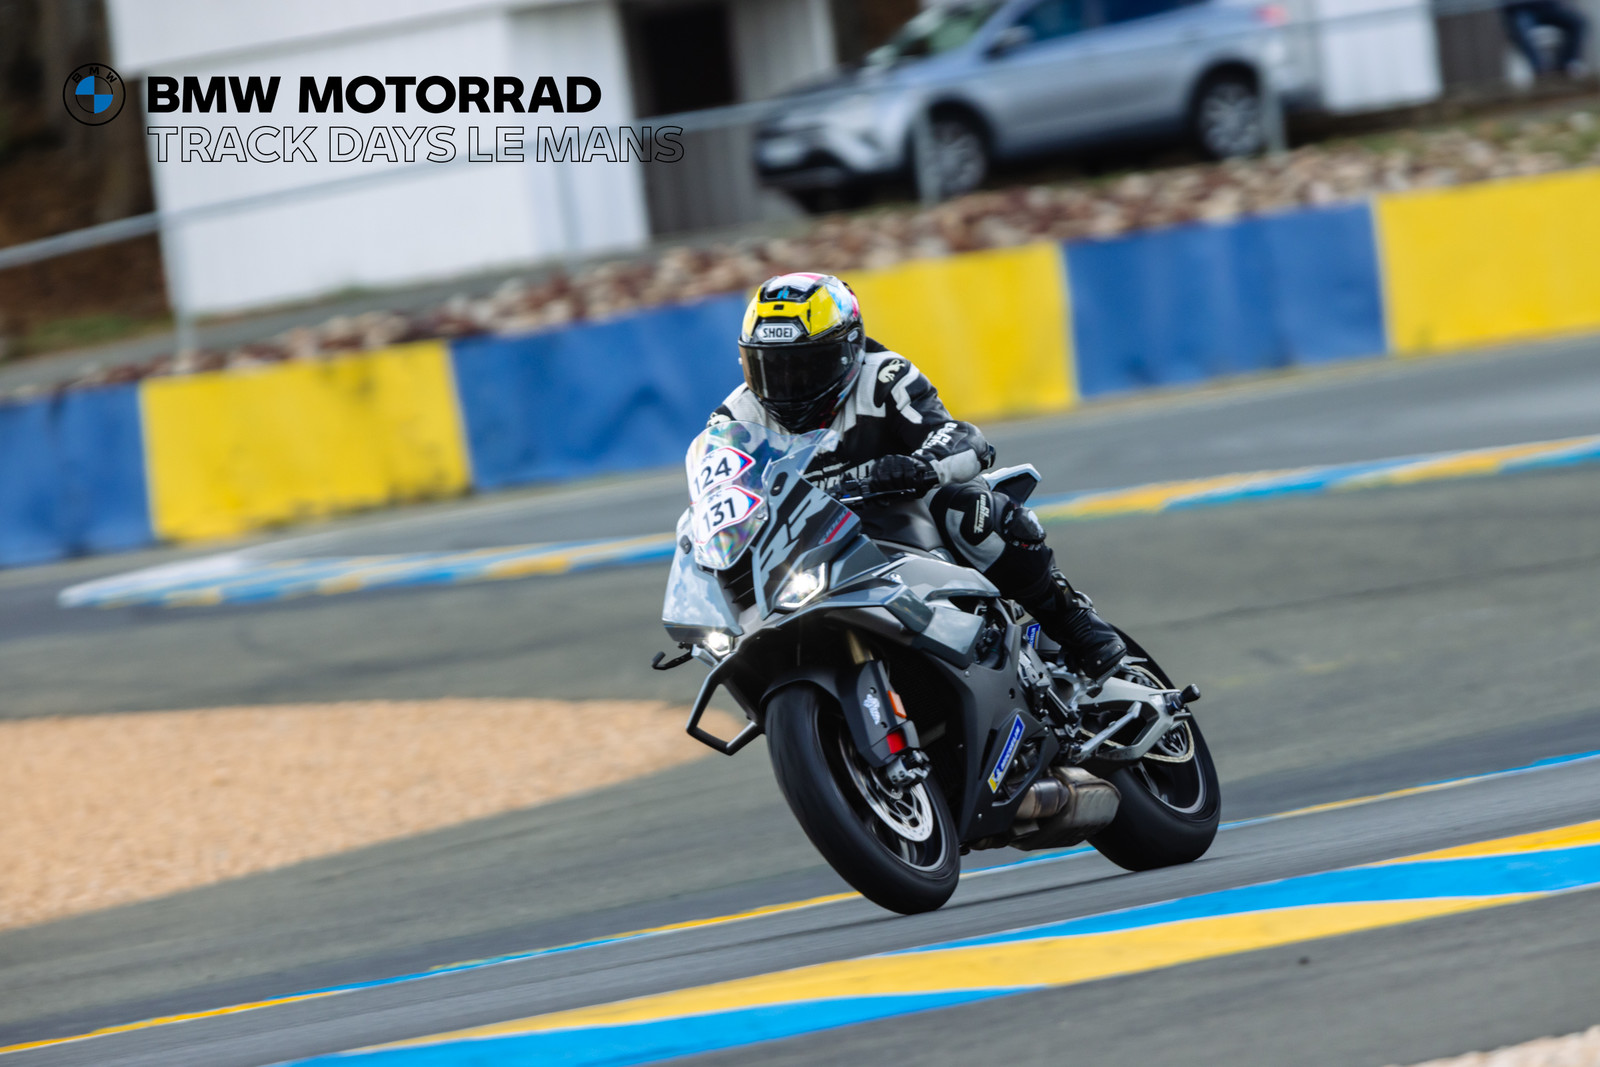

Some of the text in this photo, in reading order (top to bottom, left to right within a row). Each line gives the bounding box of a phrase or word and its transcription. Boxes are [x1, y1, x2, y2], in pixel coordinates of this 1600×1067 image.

[762, 327, 793, 338] SHOEI
[694, 457, 732, 495] 124
[703, 497, 736, 532] 131
